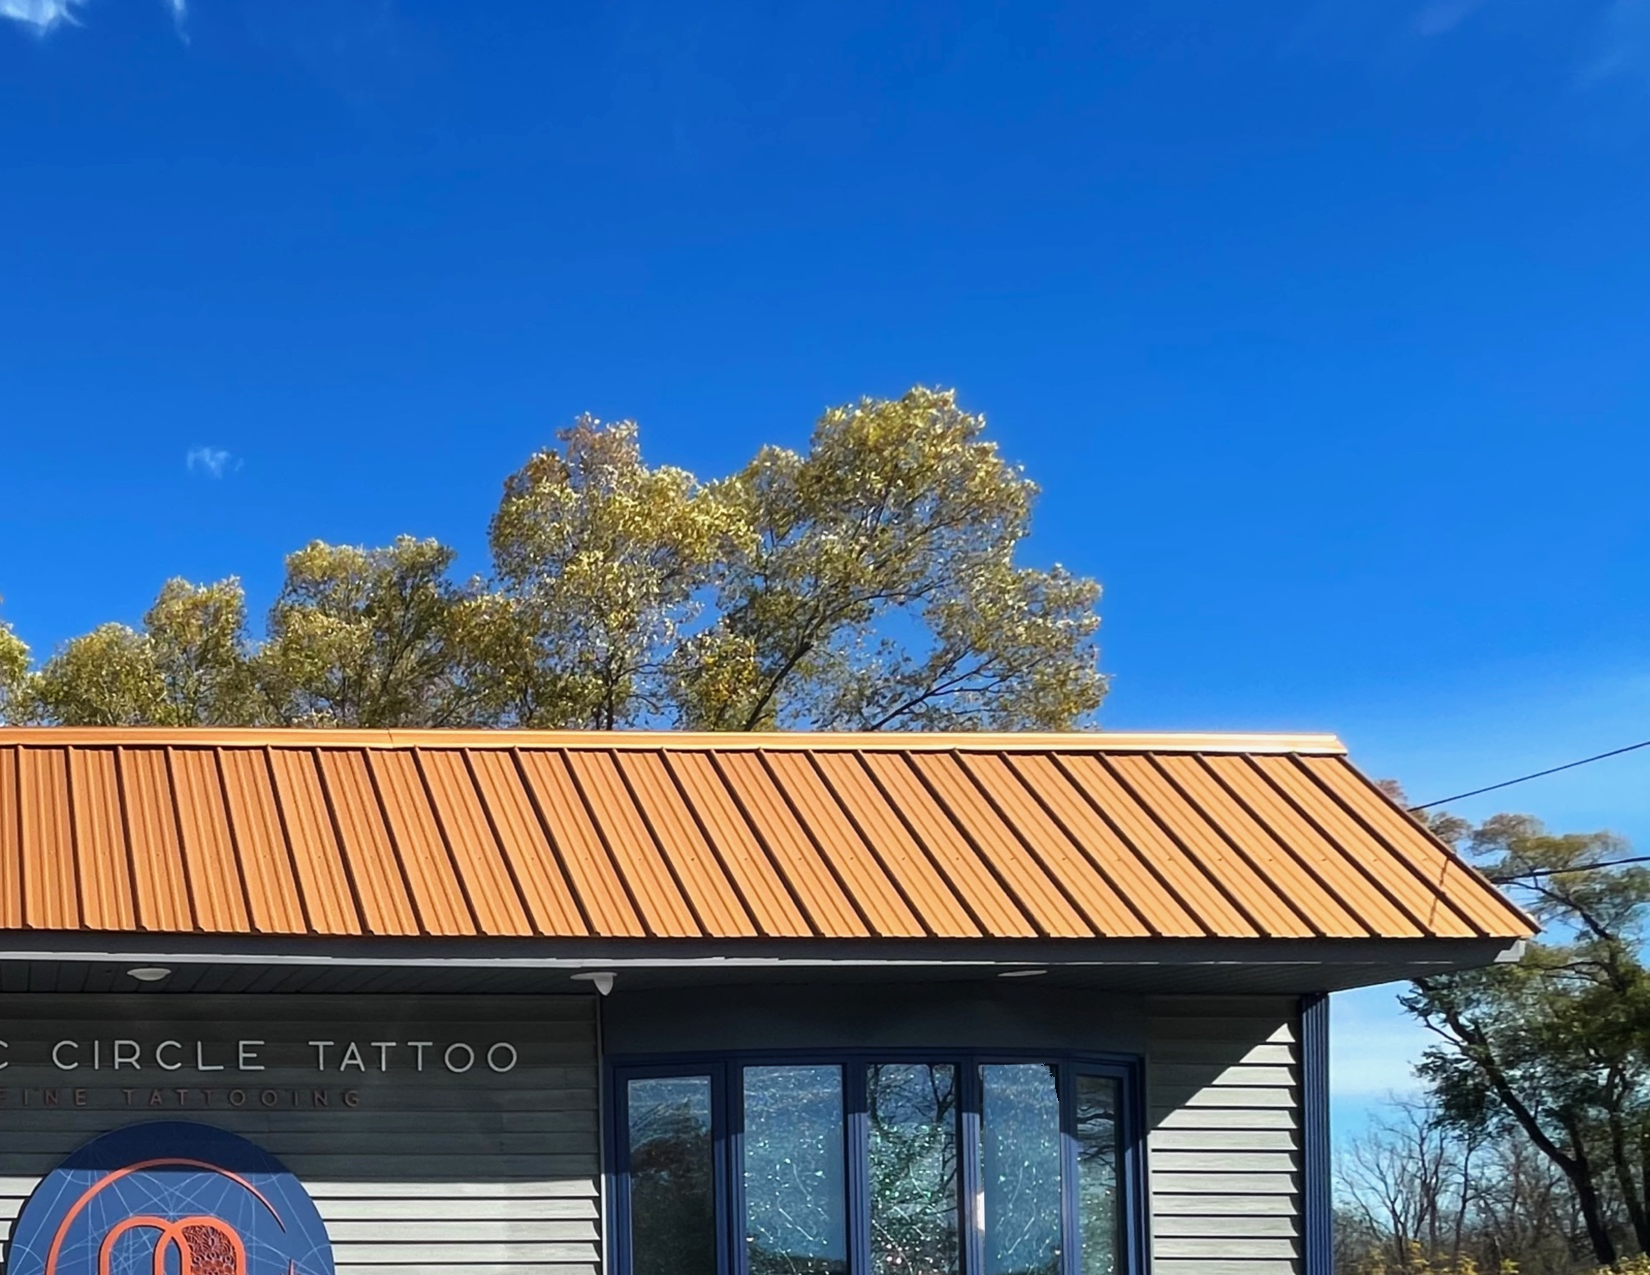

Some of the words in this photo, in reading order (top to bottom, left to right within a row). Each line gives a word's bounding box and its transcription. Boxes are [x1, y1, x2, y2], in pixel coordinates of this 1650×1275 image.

[52, 1039, 265, 1071] CIRCLE
[309, 1041, 518, 1073] TATTOO
[123, 1088, 362, 1108] TATTOOING
